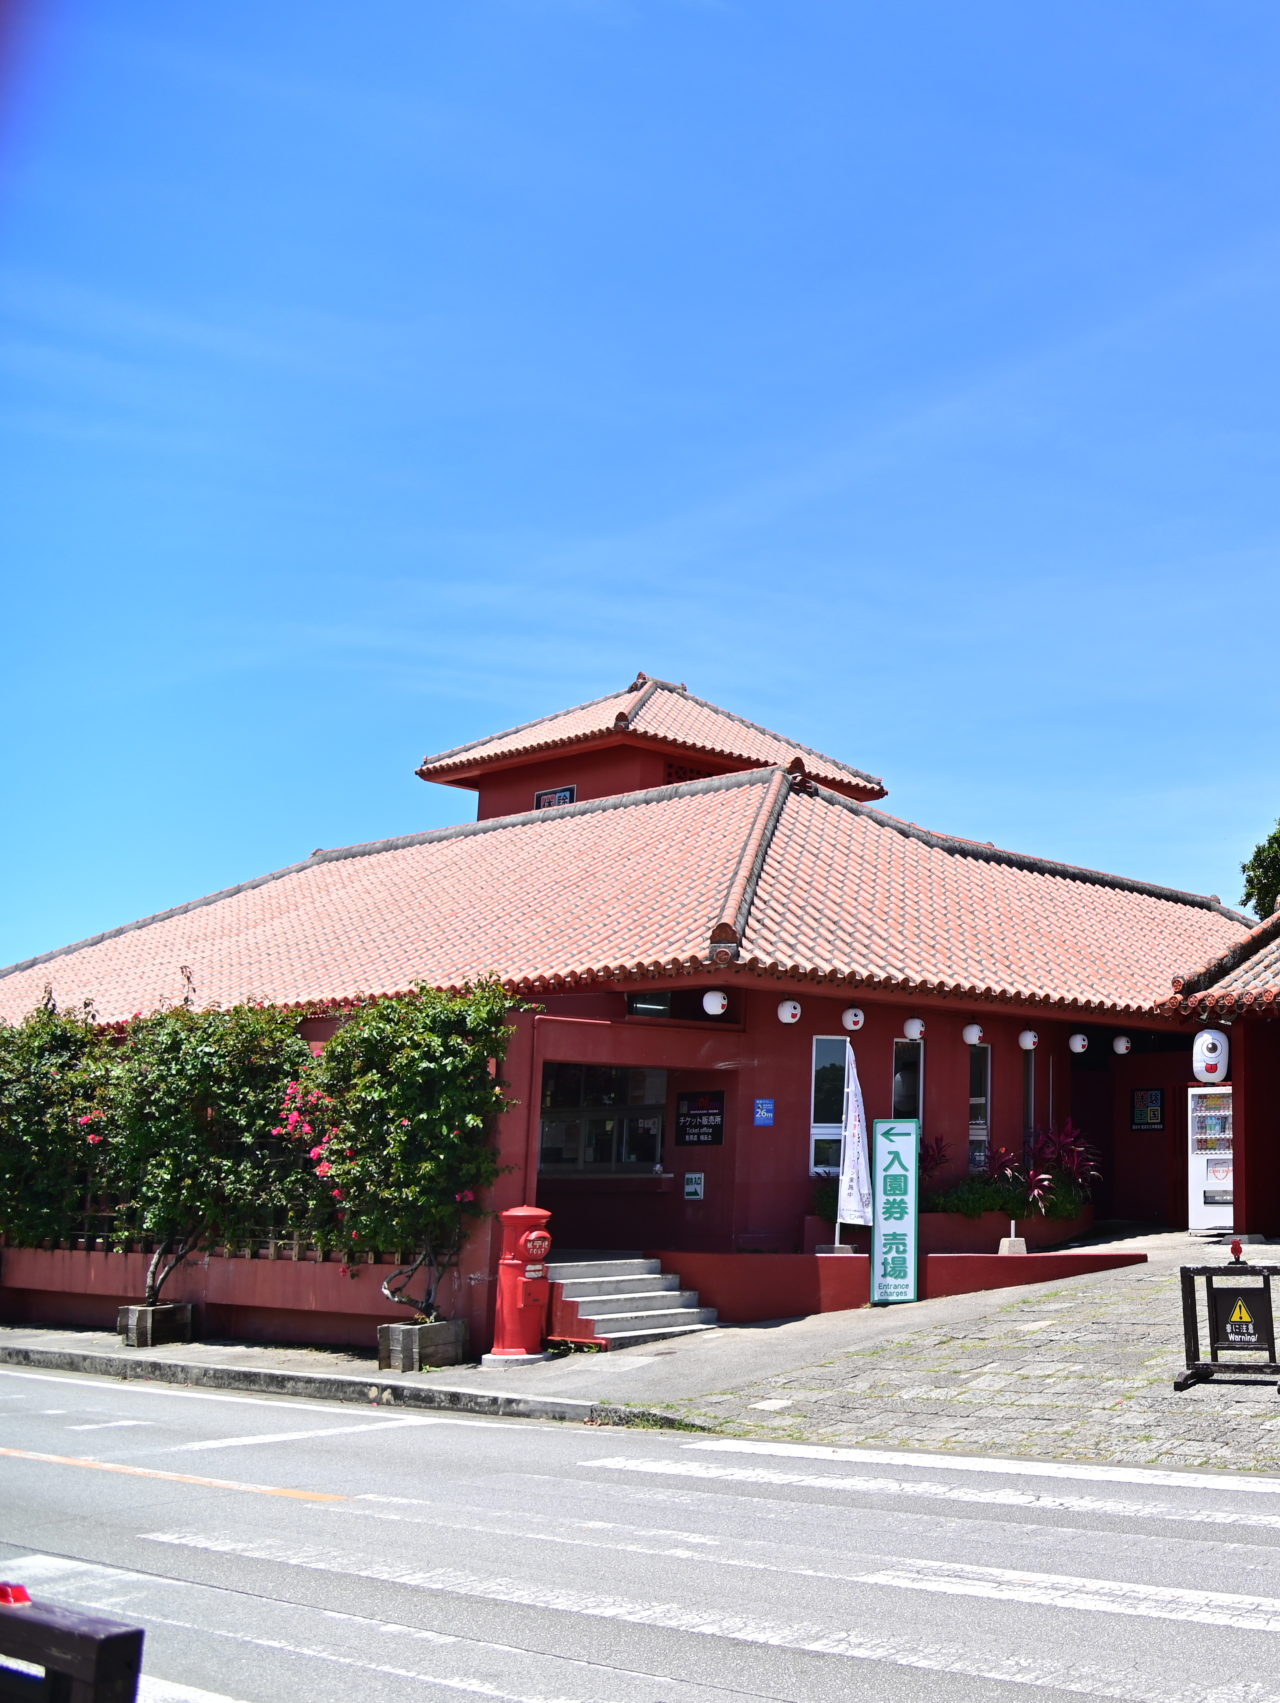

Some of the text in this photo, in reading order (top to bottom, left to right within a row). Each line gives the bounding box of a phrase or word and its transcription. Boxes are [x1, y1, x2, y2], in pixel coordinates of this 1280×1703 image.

[756, 1109, 773, 1118] 26m
[680, 1115, 721, 1126] チケット販売所
[880, 1290, 908, 1298] charges
[1228, 1333, 1258, 1342] Warning!
